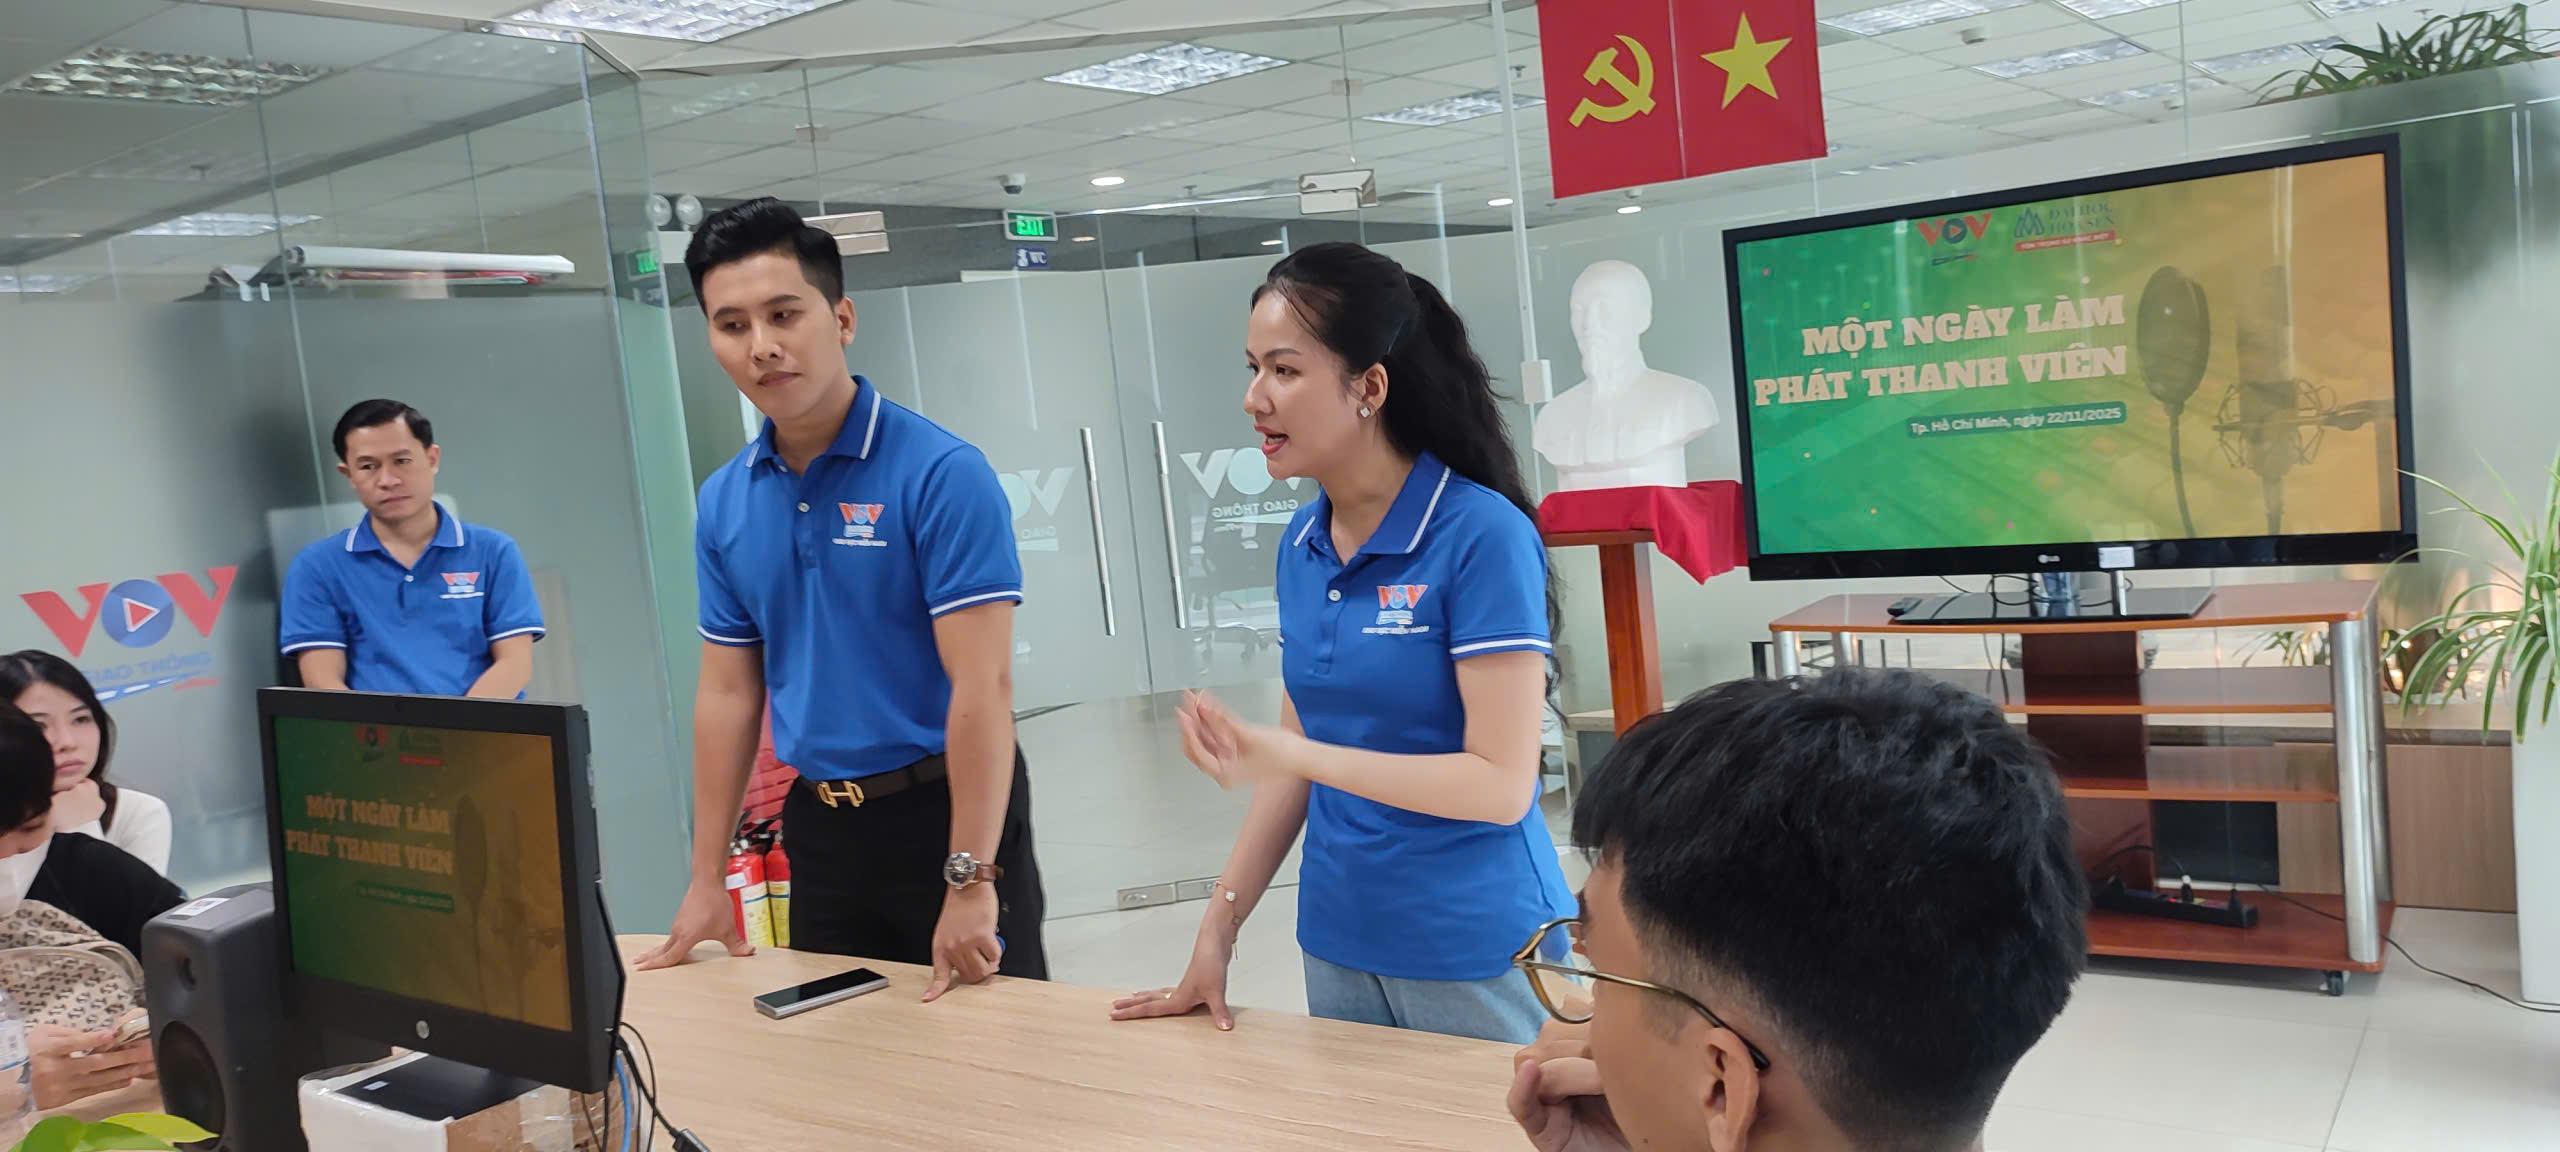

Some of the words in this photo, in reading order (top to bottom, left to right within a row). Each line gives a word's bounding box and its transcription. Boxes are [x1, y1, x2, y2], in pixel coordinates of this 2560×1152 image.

[1915, 212, 1993, 246] VOV
[1029, 251, 1048, 264] WC
[1801, 316, 1892, 358] MỘT
[1901, 304, 2014, 346] NGÀY
[2024, 294, 2125, 333] LÀM
[1754, 368, 1852, 406] PHÁT
[1862, 356, 2009, 396] THANH
[2018, 342, 2127, 383] VIÊN
[1910, 422, 1930, 436] Tp.
[1952, 417, 1974, 431] Chí
[1975, 415, 2012, 429] Minh,
[2013, 413, 2045, 428] ngày
[2047, 406, 2122, 424] 22/11/2025
[838, 502, 885, 525] VOV
[18, 565, 239, 659] VOV
[1376, 584, 1428, 609] VOV
[306, 792, 347, 824] MỘT
[351, 799, 401, 828] NGÀY
[405, 803, 450, 835] LÀM
[286, 828, 330, 857] PHÁT
[334, 835, 401, 867] THANH
